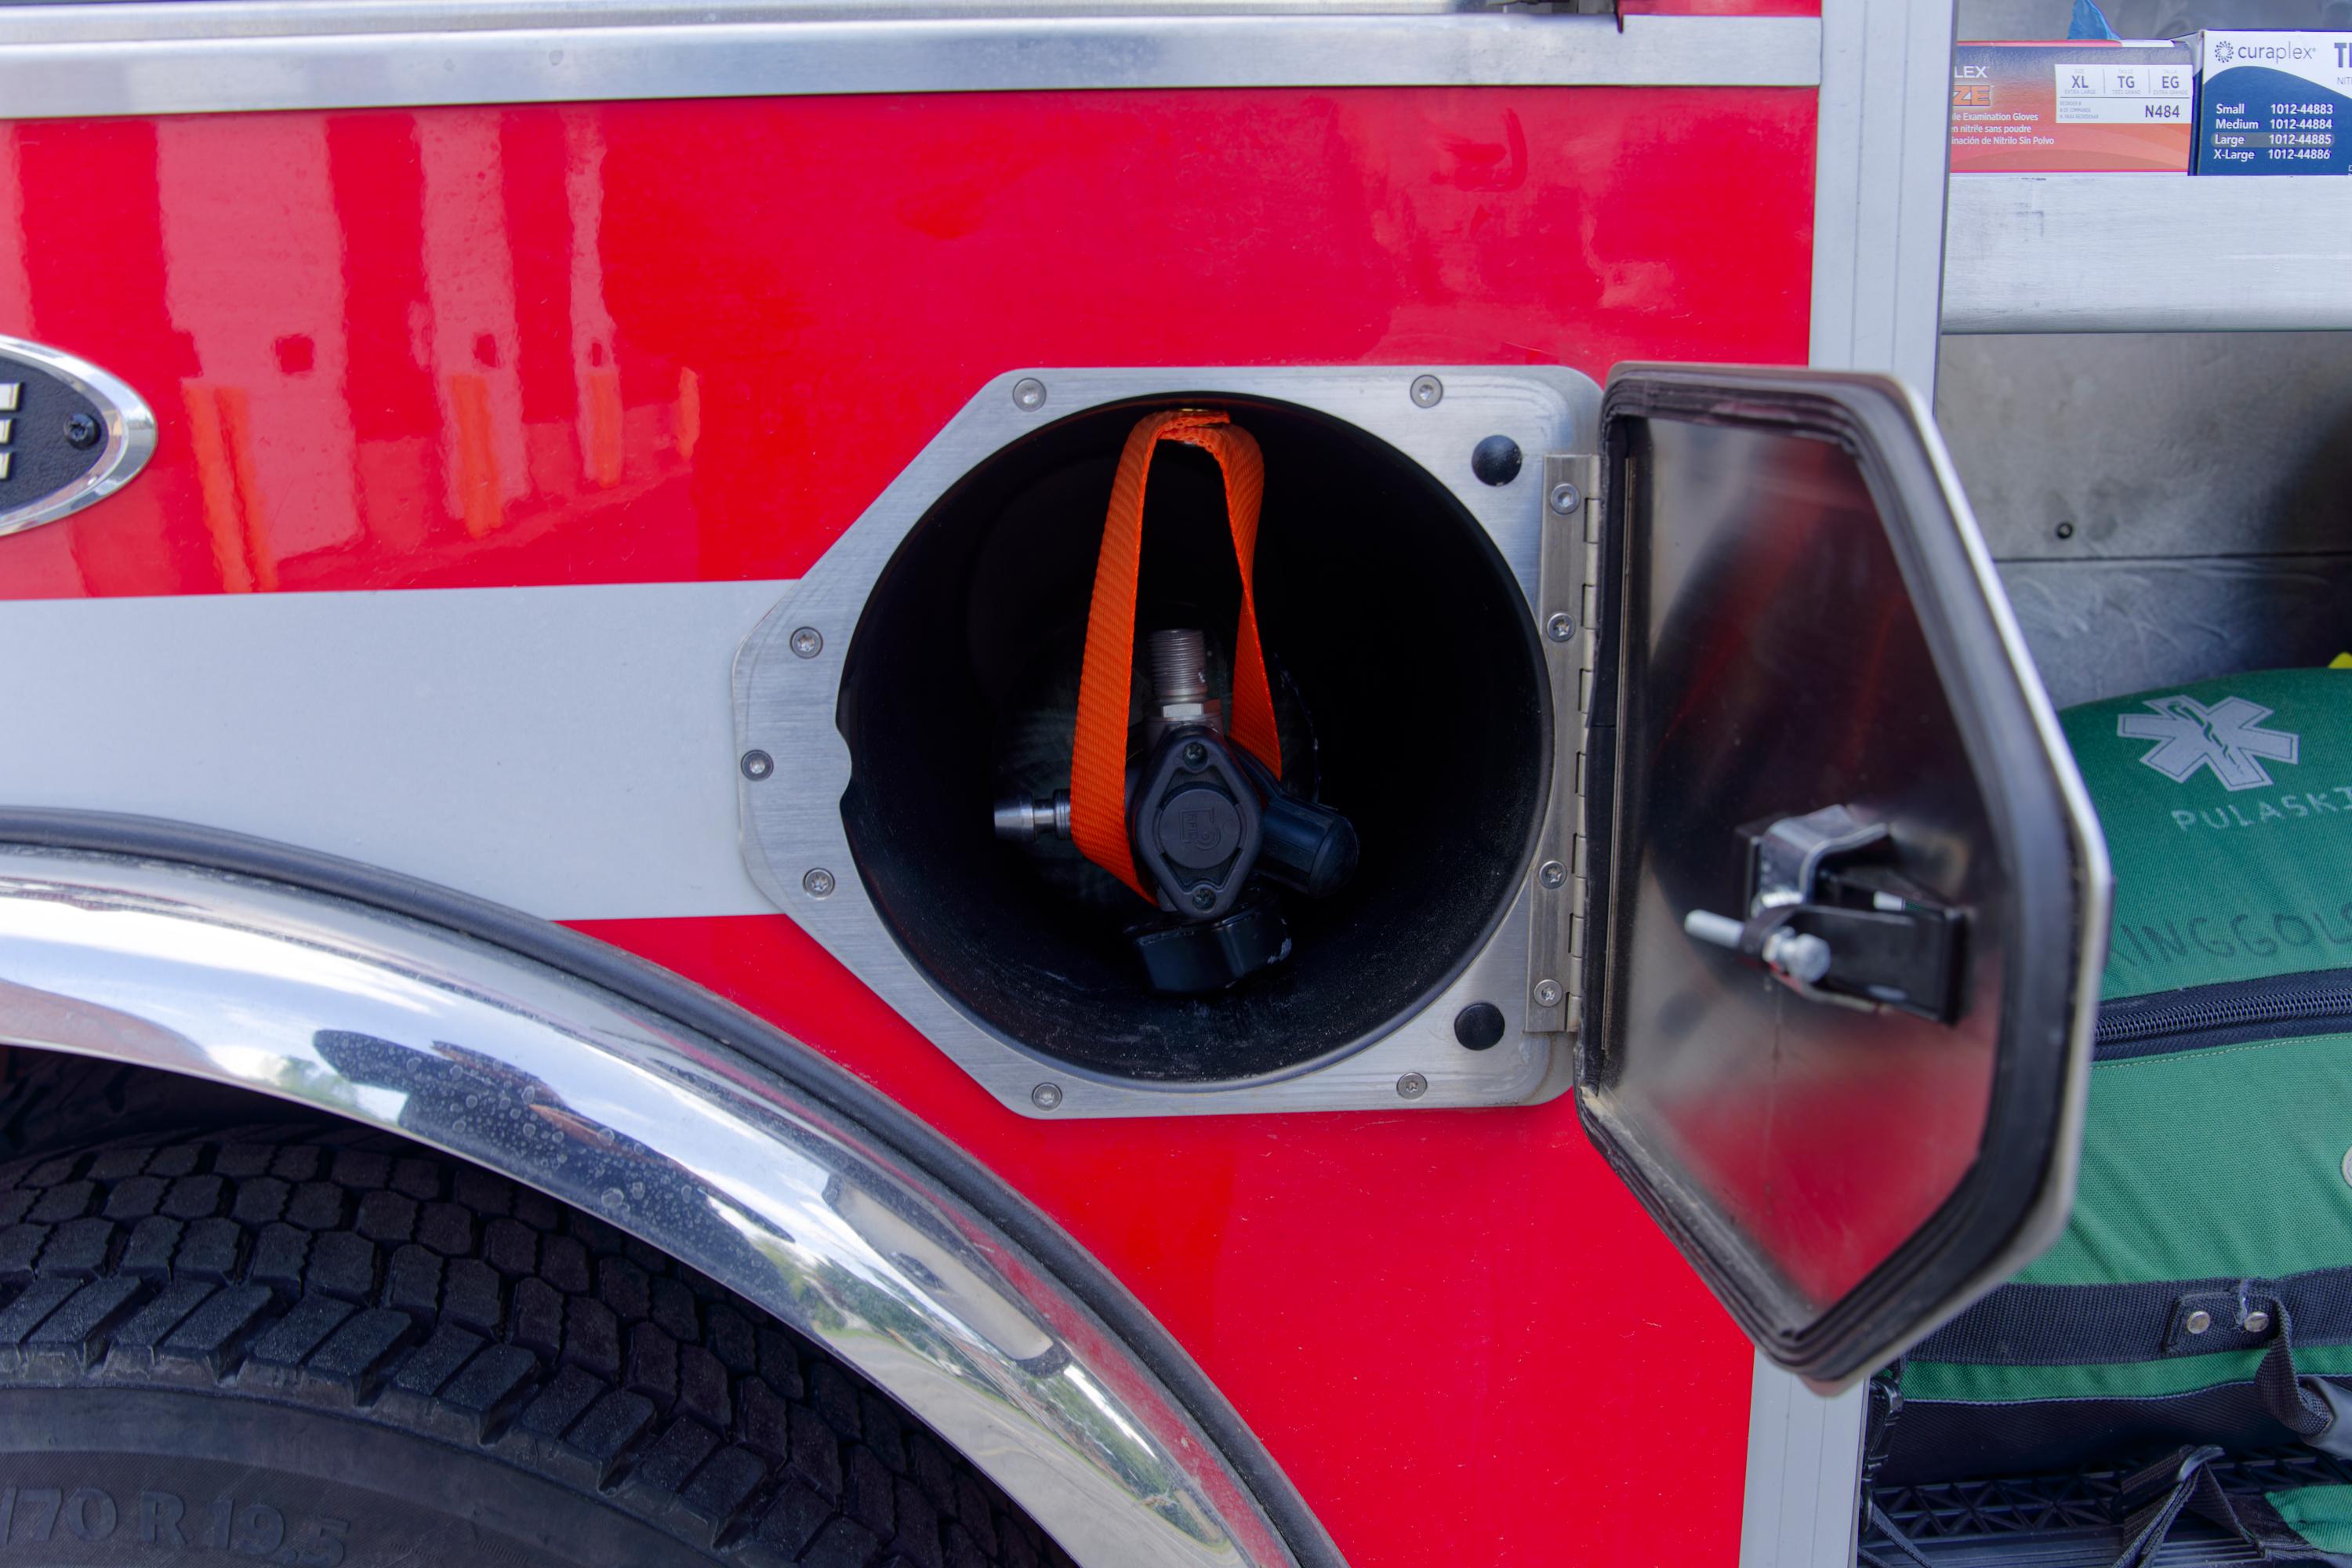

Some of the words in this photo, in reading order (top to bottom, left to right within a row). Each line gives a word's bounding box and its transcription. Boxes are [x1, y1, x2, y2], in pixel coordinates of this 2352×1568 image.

[2238, 41, 2313, 64] curaplex
[2334, 42, 2352, 67] T
[1954, 66, 1987, 78] LEX
[2071, 75, 2089, 88] XL
[2118, 76, 2135, 89] TG
[2161, 76, 2180, 89] EG
[1953, 85, 1991, 106] ZE
[2145, 104, 2180, 118] N484
[2216, 103, 2245, 114] Small
[2270, 103, 2333, 114] 1012-44883
[2004, 125, 2032, 134] poudre
[2216, 118, 2259, 129] Medium
[2270, 118, 2332, 129] 1012-44884
[1994, 136, 2017, 145] Nitrilo
[2033, 136, 2054, 145] Polvo
[2215, 134, 2245, 147] Large
[2269, 134, 2332, 144] 1012-44885
[2213, 149, 2255, 162] X-Large
[2268, 149, 2331, 160] 1012-44886
[139, 1490, 188, 1545] R
[207, 1496, 351, 1568] 19.5
